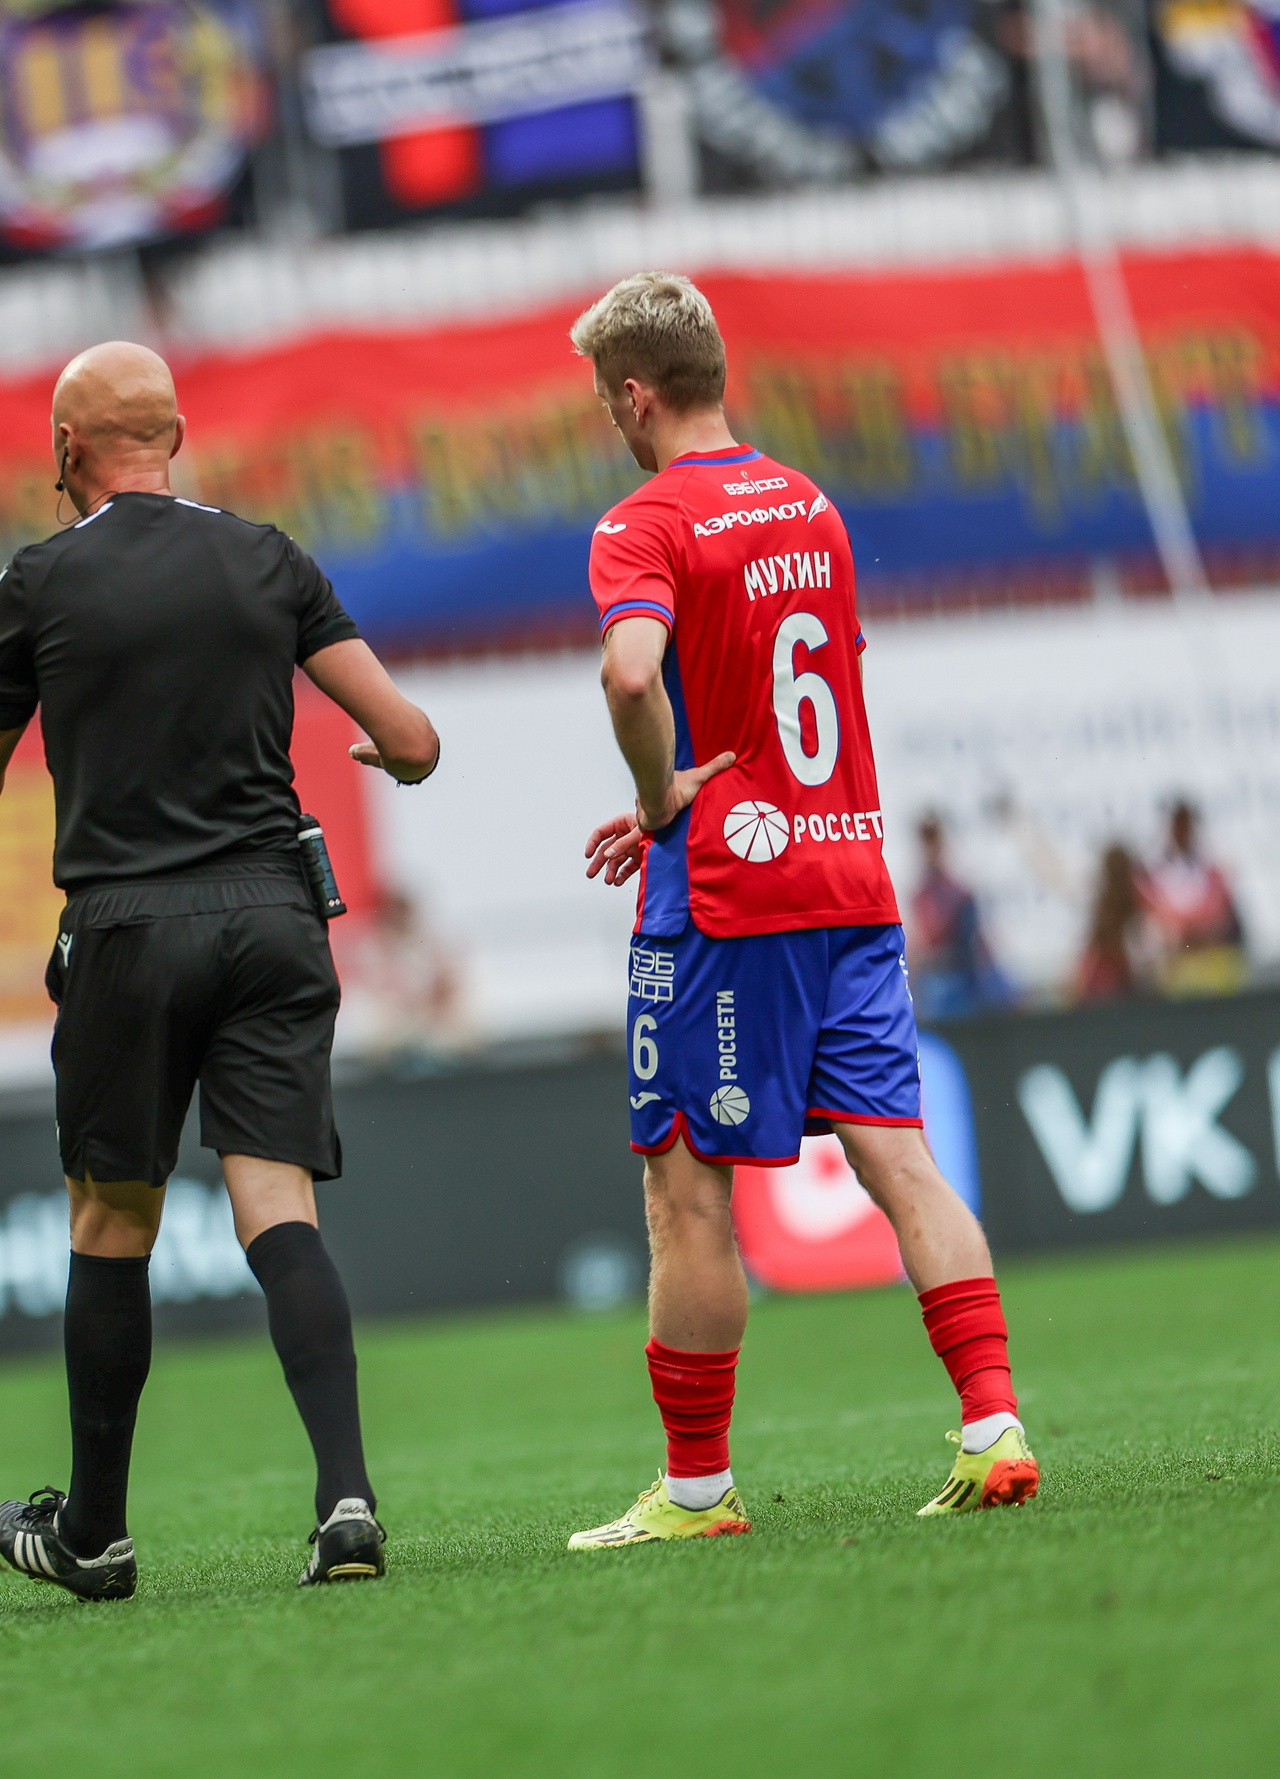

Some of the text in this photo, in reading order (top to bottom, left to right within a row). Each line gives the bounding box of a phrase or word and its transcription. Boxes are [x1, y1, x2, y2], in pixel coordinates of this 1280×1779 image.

[693, 500, 807, 540] АЭРОФЛОТ
[743, 551, 831, 602] МУХИН
[772, 611, 840, 787] 6
[793, 809, 884, 843] РОССЕТ
[632, 1013, 659, 1081] 6
[716, 989, 738, 1081] РОССЕТИ
[1018, 1047, 1257, 1214] VK
